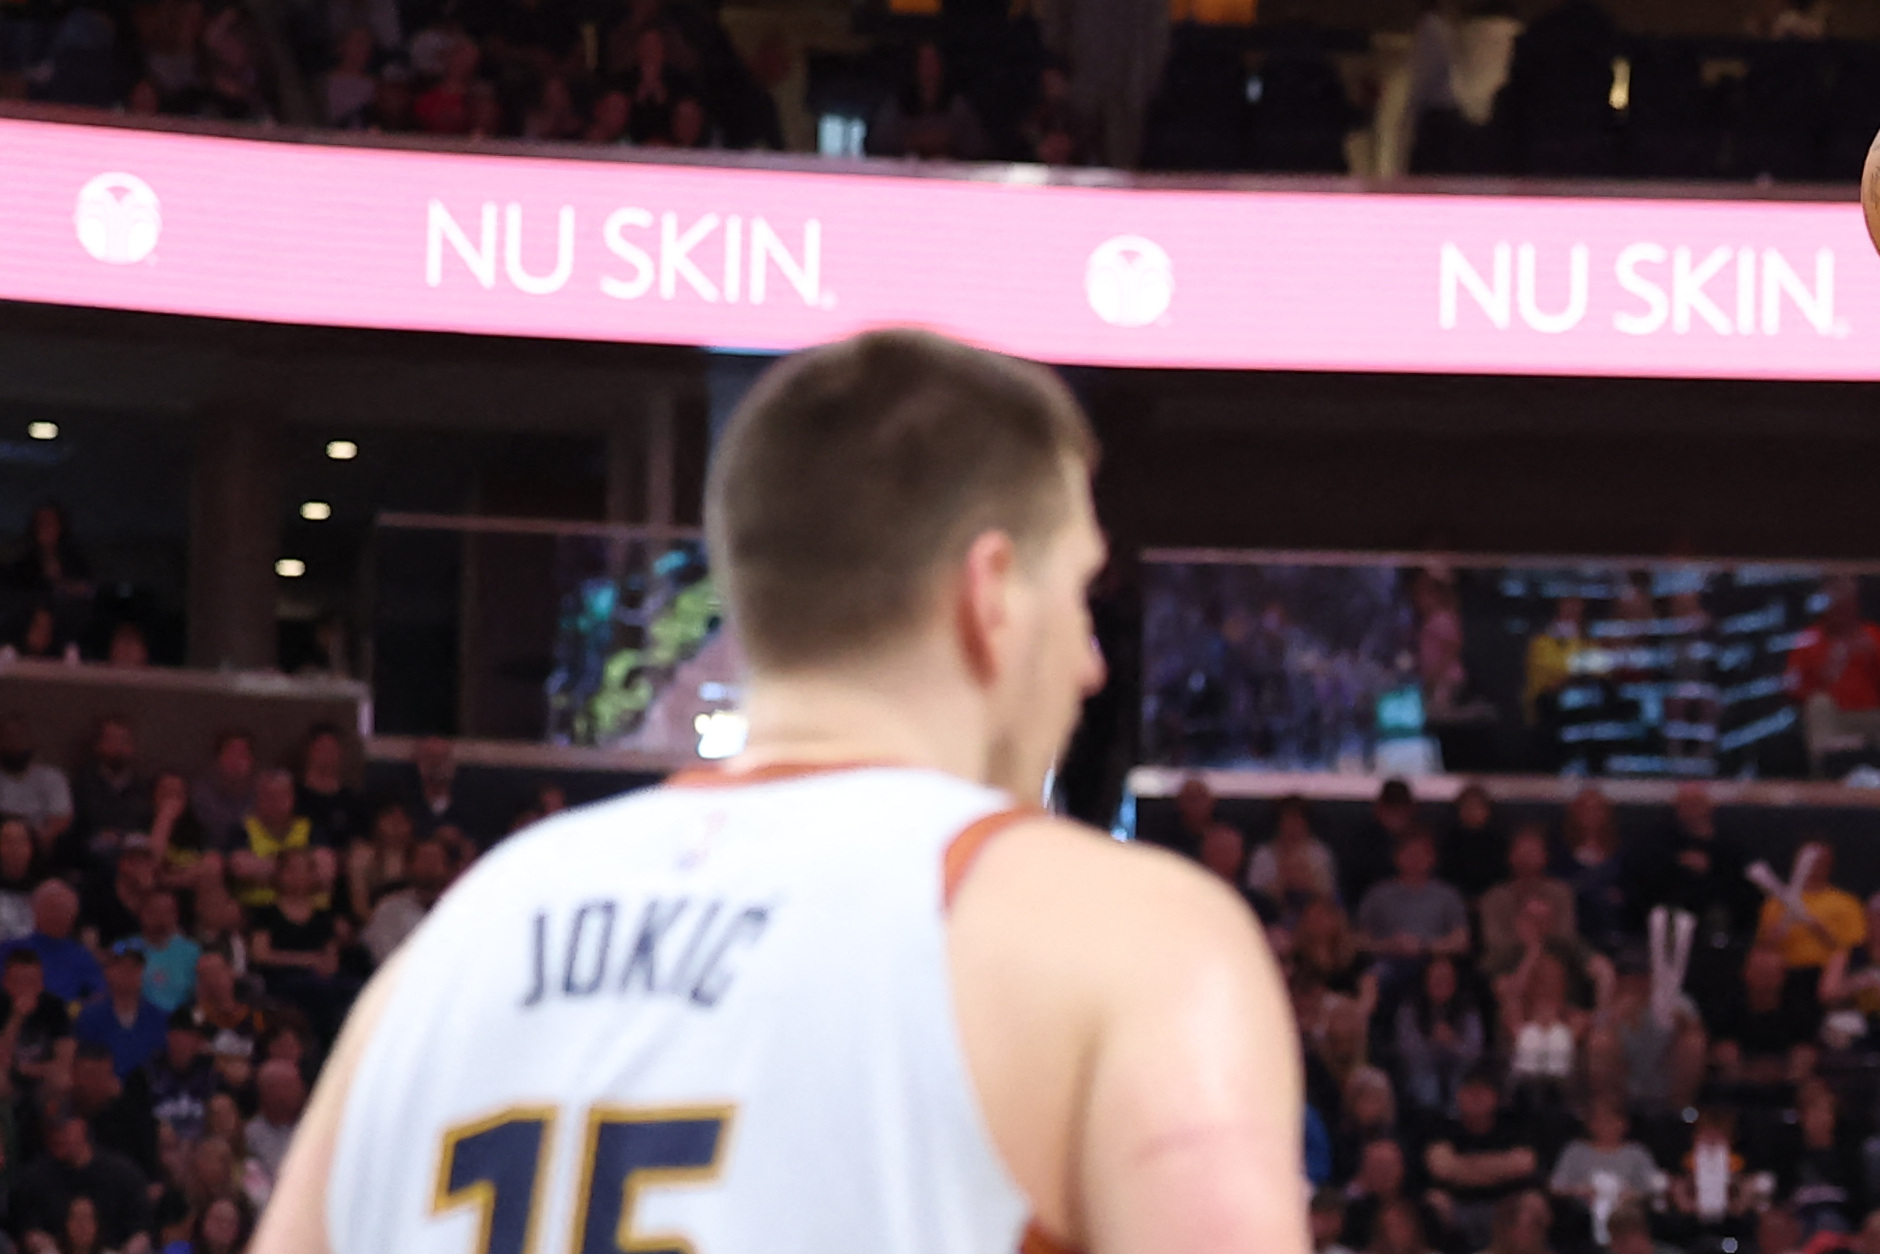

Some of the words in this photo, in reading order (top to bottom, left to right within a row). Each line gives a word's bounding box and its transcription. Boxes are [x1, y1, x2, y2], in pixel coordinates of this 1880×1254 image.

[425, 197, 576, 295] NU
[601, 206, 823, 308] SKIN
[1438, 239, 1589, 334] NU
[1611, 242, 1835, 336] SKIN
